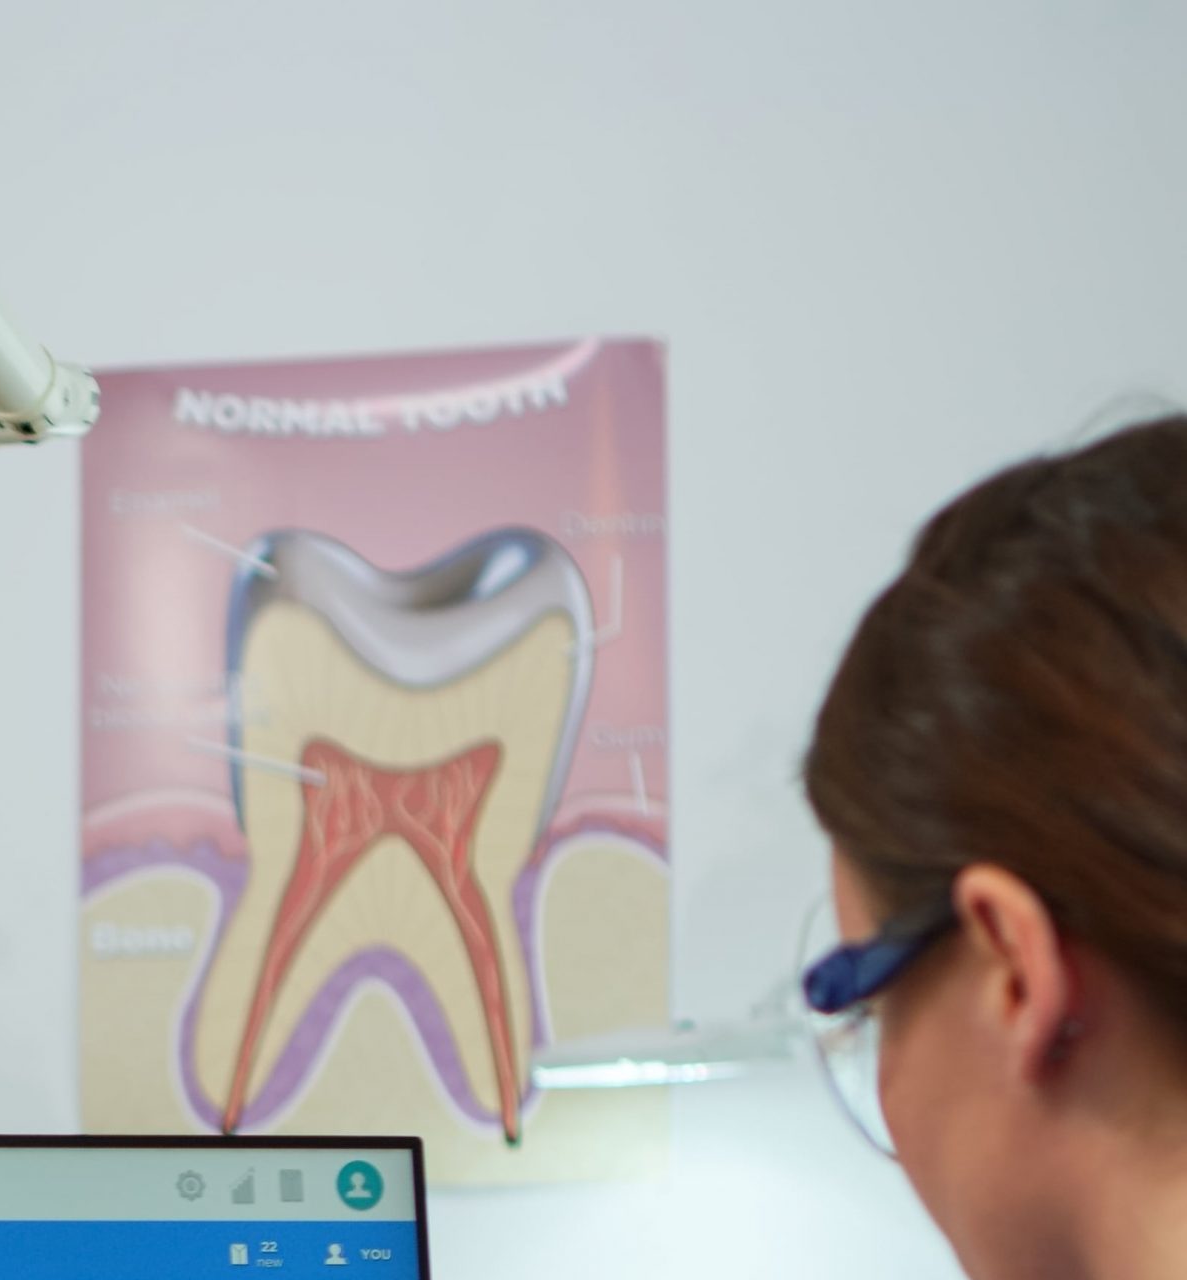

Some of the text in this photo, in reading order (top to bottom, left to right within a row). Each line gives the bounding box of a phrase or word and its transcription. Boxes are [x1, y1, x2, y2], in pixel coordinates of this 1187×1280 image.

[175, 371, 568, 436] NORMAL TOOTH
[92, 924, 193, 955] Bone
[261, 1241, 278, 1253] 22
[360, 1249, 391, 1261] YOU
[257, 1258, 284, 1268] new
